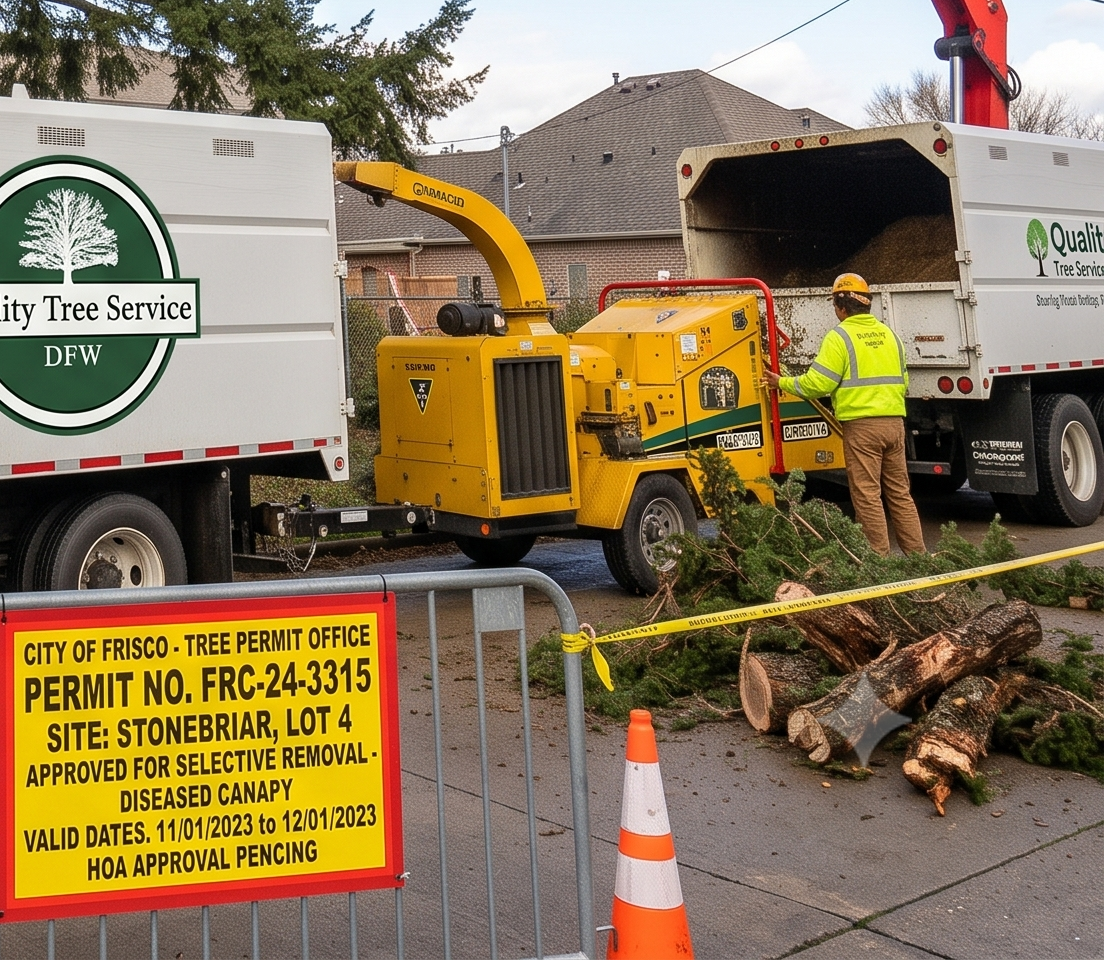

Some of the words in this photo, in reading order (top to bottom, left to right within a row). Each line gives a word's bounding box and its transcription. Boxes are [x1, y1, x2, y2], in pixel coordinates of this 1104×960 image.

[1053, 260, 1075, 277] Tree
[43, 295, 99, 321] Tree
[107, 294, 192, 321] Service
[44, 344, 102, 367] DFW
[24, 641, 67, 666] CITY
[72, 639, 96, 664] OF
[102, 635, 169, 661] FRISCO
[184, 632, 231, 657] TREE
[236, 628, 303, 654] PERMIT
[308, 624, 371, 650] OFFICE
[25, 671, 134, 714] PERMIT
[144, 669, 192, 707] NO.
[201, 657, 372, 702] FRC-24-3315
[47, 720, 109, 753] SITE:
[117, 710, 279, 749] STONEBRIAR,
[286, 705, 331, 737] LOT
[338, 703, 352, 733] 4
[26, 758, 128, 788] APPROVED
[133, 755, 170, 780] FOR
[176, 748, 276, 777] SELECTIVE
[282, 741, 368, 770] REMOVAL
[120, 784, 212, 813] DISEASED
[218, 778, 294, 806] CANAPY
[23, 826, 79, 853] VALID
[86, 821, 151, 849] DATES.
[156, 812, 254, 843] 11/01/2023
[258, 813, 277, 835] to
[282, 803, 377, 833] 12/01/2023
[87, 855, 128, 881] HOA
[132, 847, 231, 878] APPROVAL
[236, 839, 318, 869] PENCING
